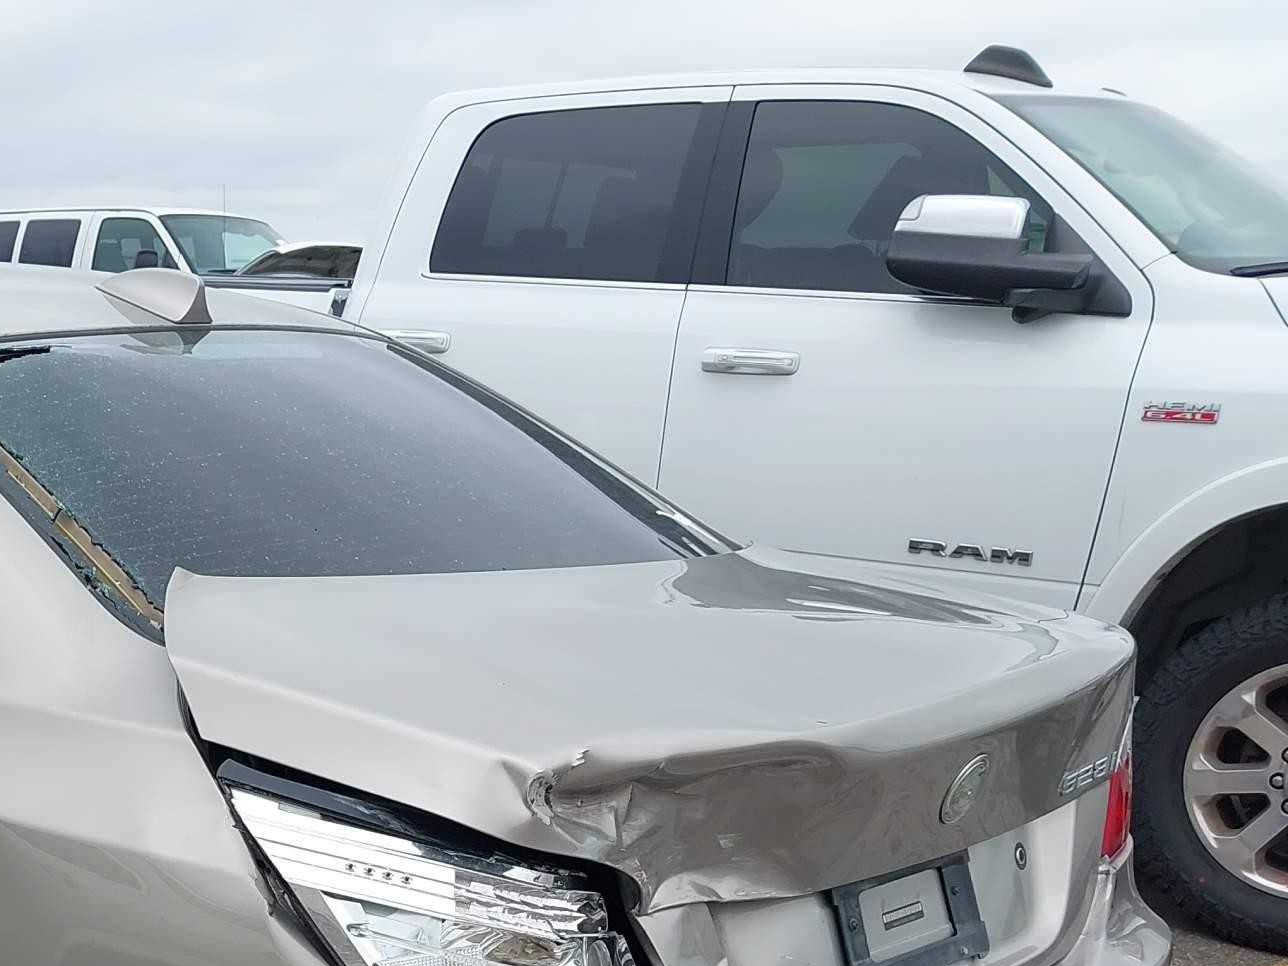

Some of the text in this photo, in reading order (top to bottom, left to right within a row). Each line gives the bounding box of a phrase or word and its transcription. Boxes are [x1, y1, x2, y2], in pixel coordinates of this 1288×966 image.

[1142, 401, 1221, 412] HEMI
[1145, 411, 1217, 422] 6.4L
[908, 537, 1033, 567] RAM
